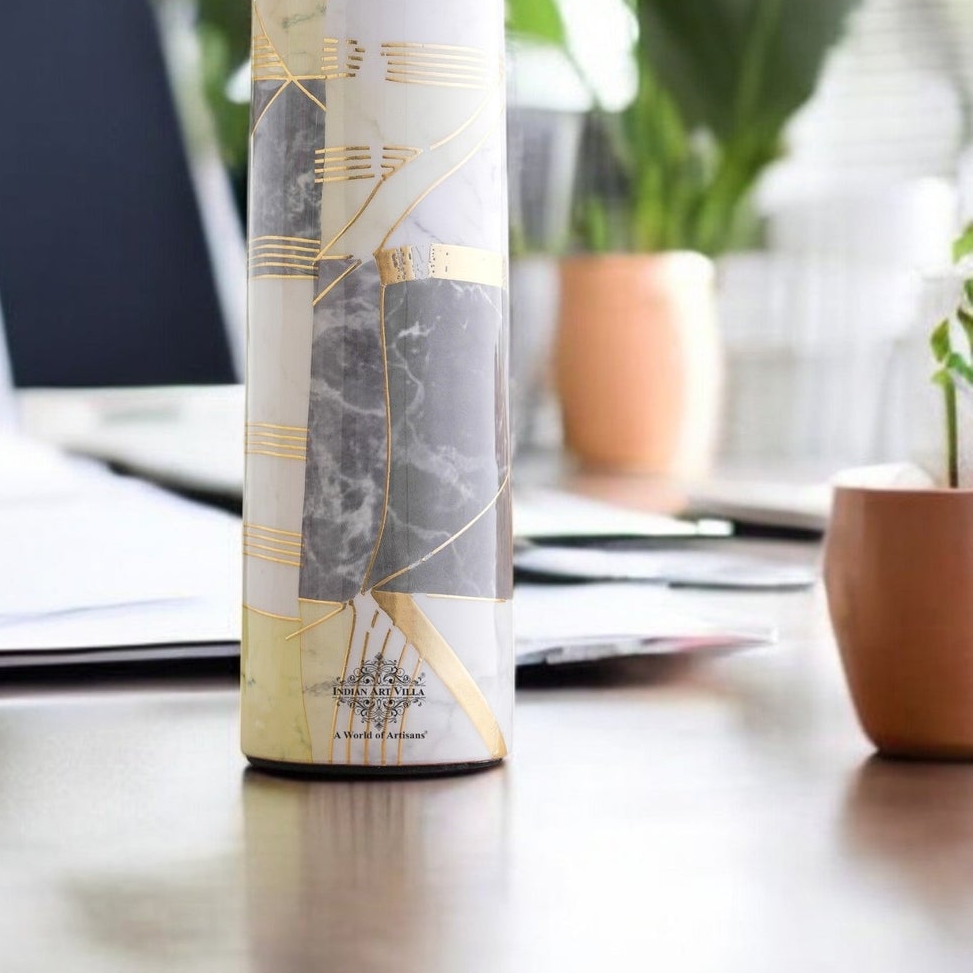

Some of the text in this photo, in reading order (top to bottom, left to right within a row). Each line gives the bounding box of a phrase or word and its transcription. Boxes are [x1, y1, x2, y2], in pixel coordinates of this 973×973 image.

[333, 687, 425, 696] INDIAN ART VILLA
[333, 731, 341, 739] A
[343, 731, 372, 739] World
[374, 731, 385, 739] of
